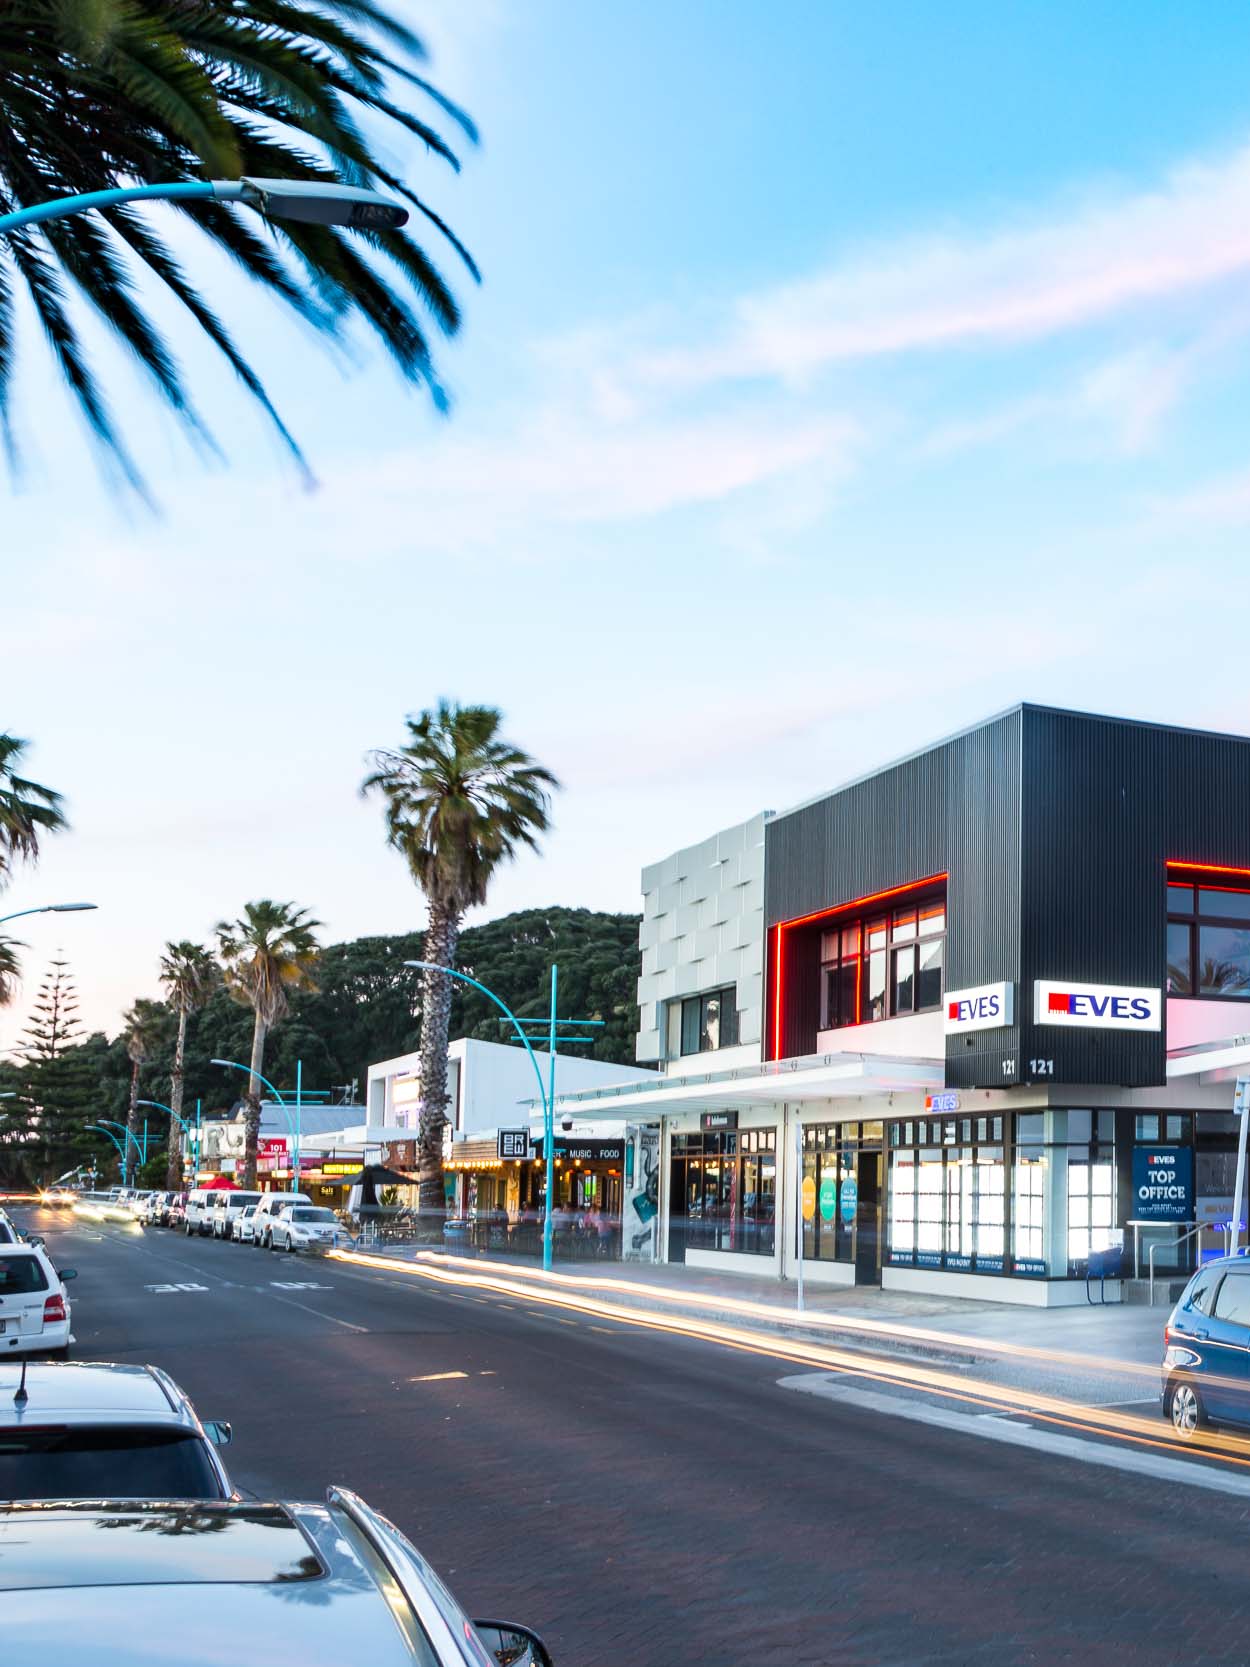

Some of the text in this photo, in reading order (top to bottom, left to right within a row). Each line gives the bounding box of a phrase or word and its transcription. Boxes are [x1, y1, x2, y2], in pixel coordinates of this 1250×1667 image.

[958, 995, 1000, 1021] EVES
[1069, 993, 1151, 1020] EVES
[1002, 1059, 1014, 1075] 121
[1030, 1059, 1053, 1074] 121
[270, 1144, 283, 1152] 101
[569, 1149, 592, 1159] MUSIC
[600, 1149, 620, 1159] FOOD
[1154, 1155, 1175, 1164] EVES
[1148, 1170, 1176, 1184] TOP
[1138, 1186, 1186, 1200] OFFICE
